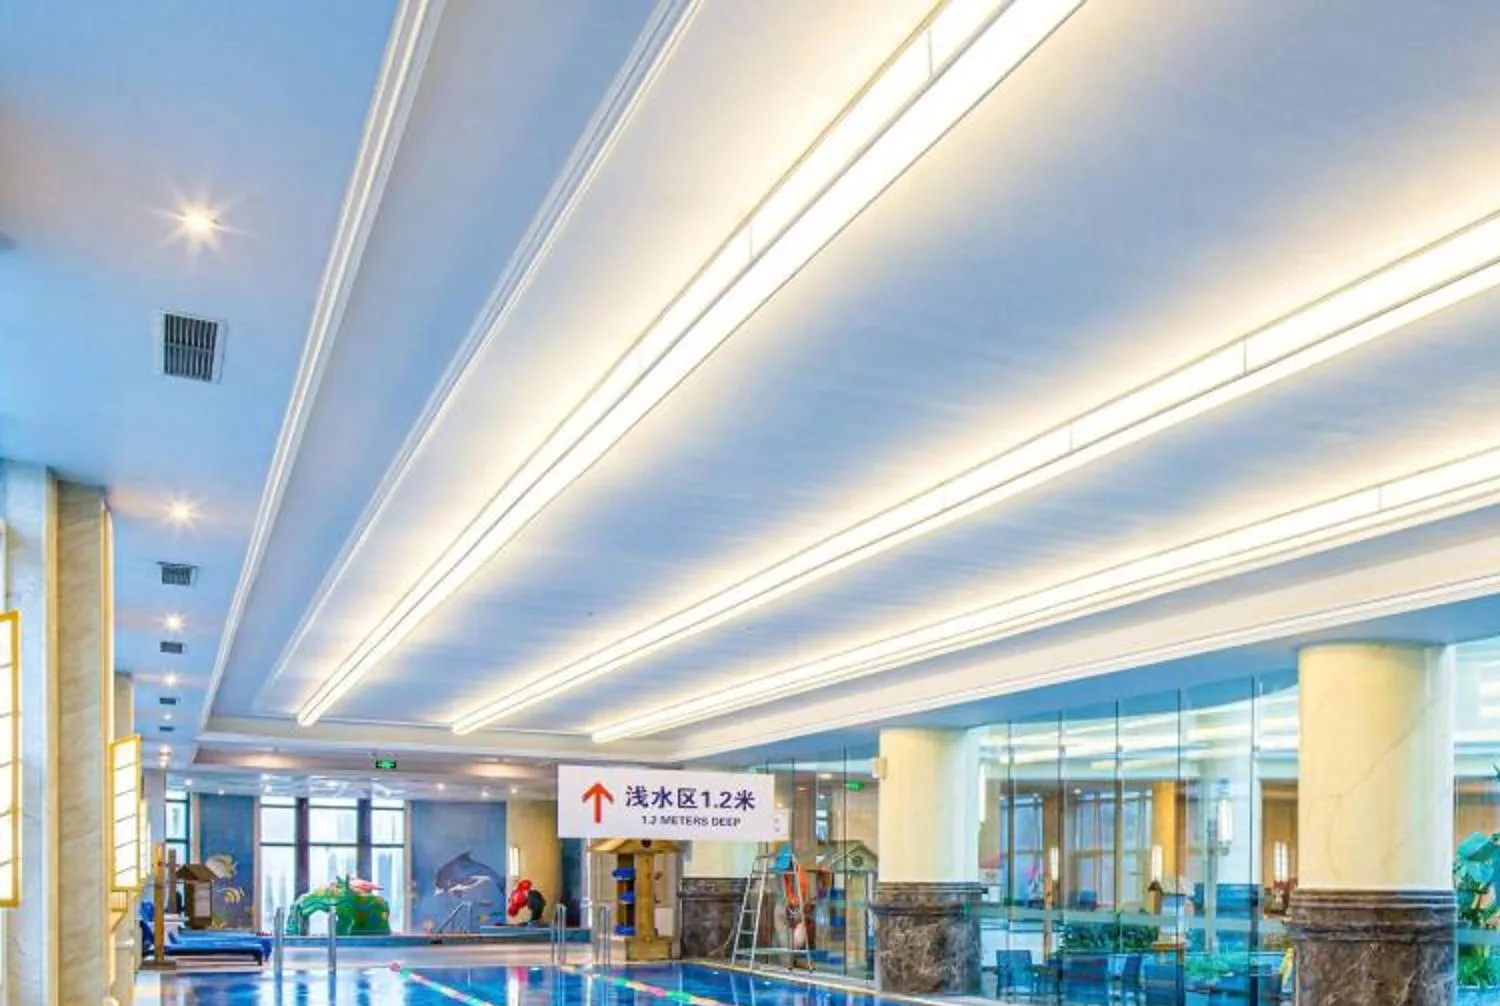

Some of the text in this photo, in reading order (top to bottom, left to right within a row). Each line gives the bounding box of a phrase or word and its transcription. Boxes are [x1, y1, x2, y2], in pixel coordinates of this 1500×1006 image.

[625, 785, 756, 811] 浅水区1.2米
[659, 816, 709, 827] METERS
[711, 817, 741, 827] DEEP
